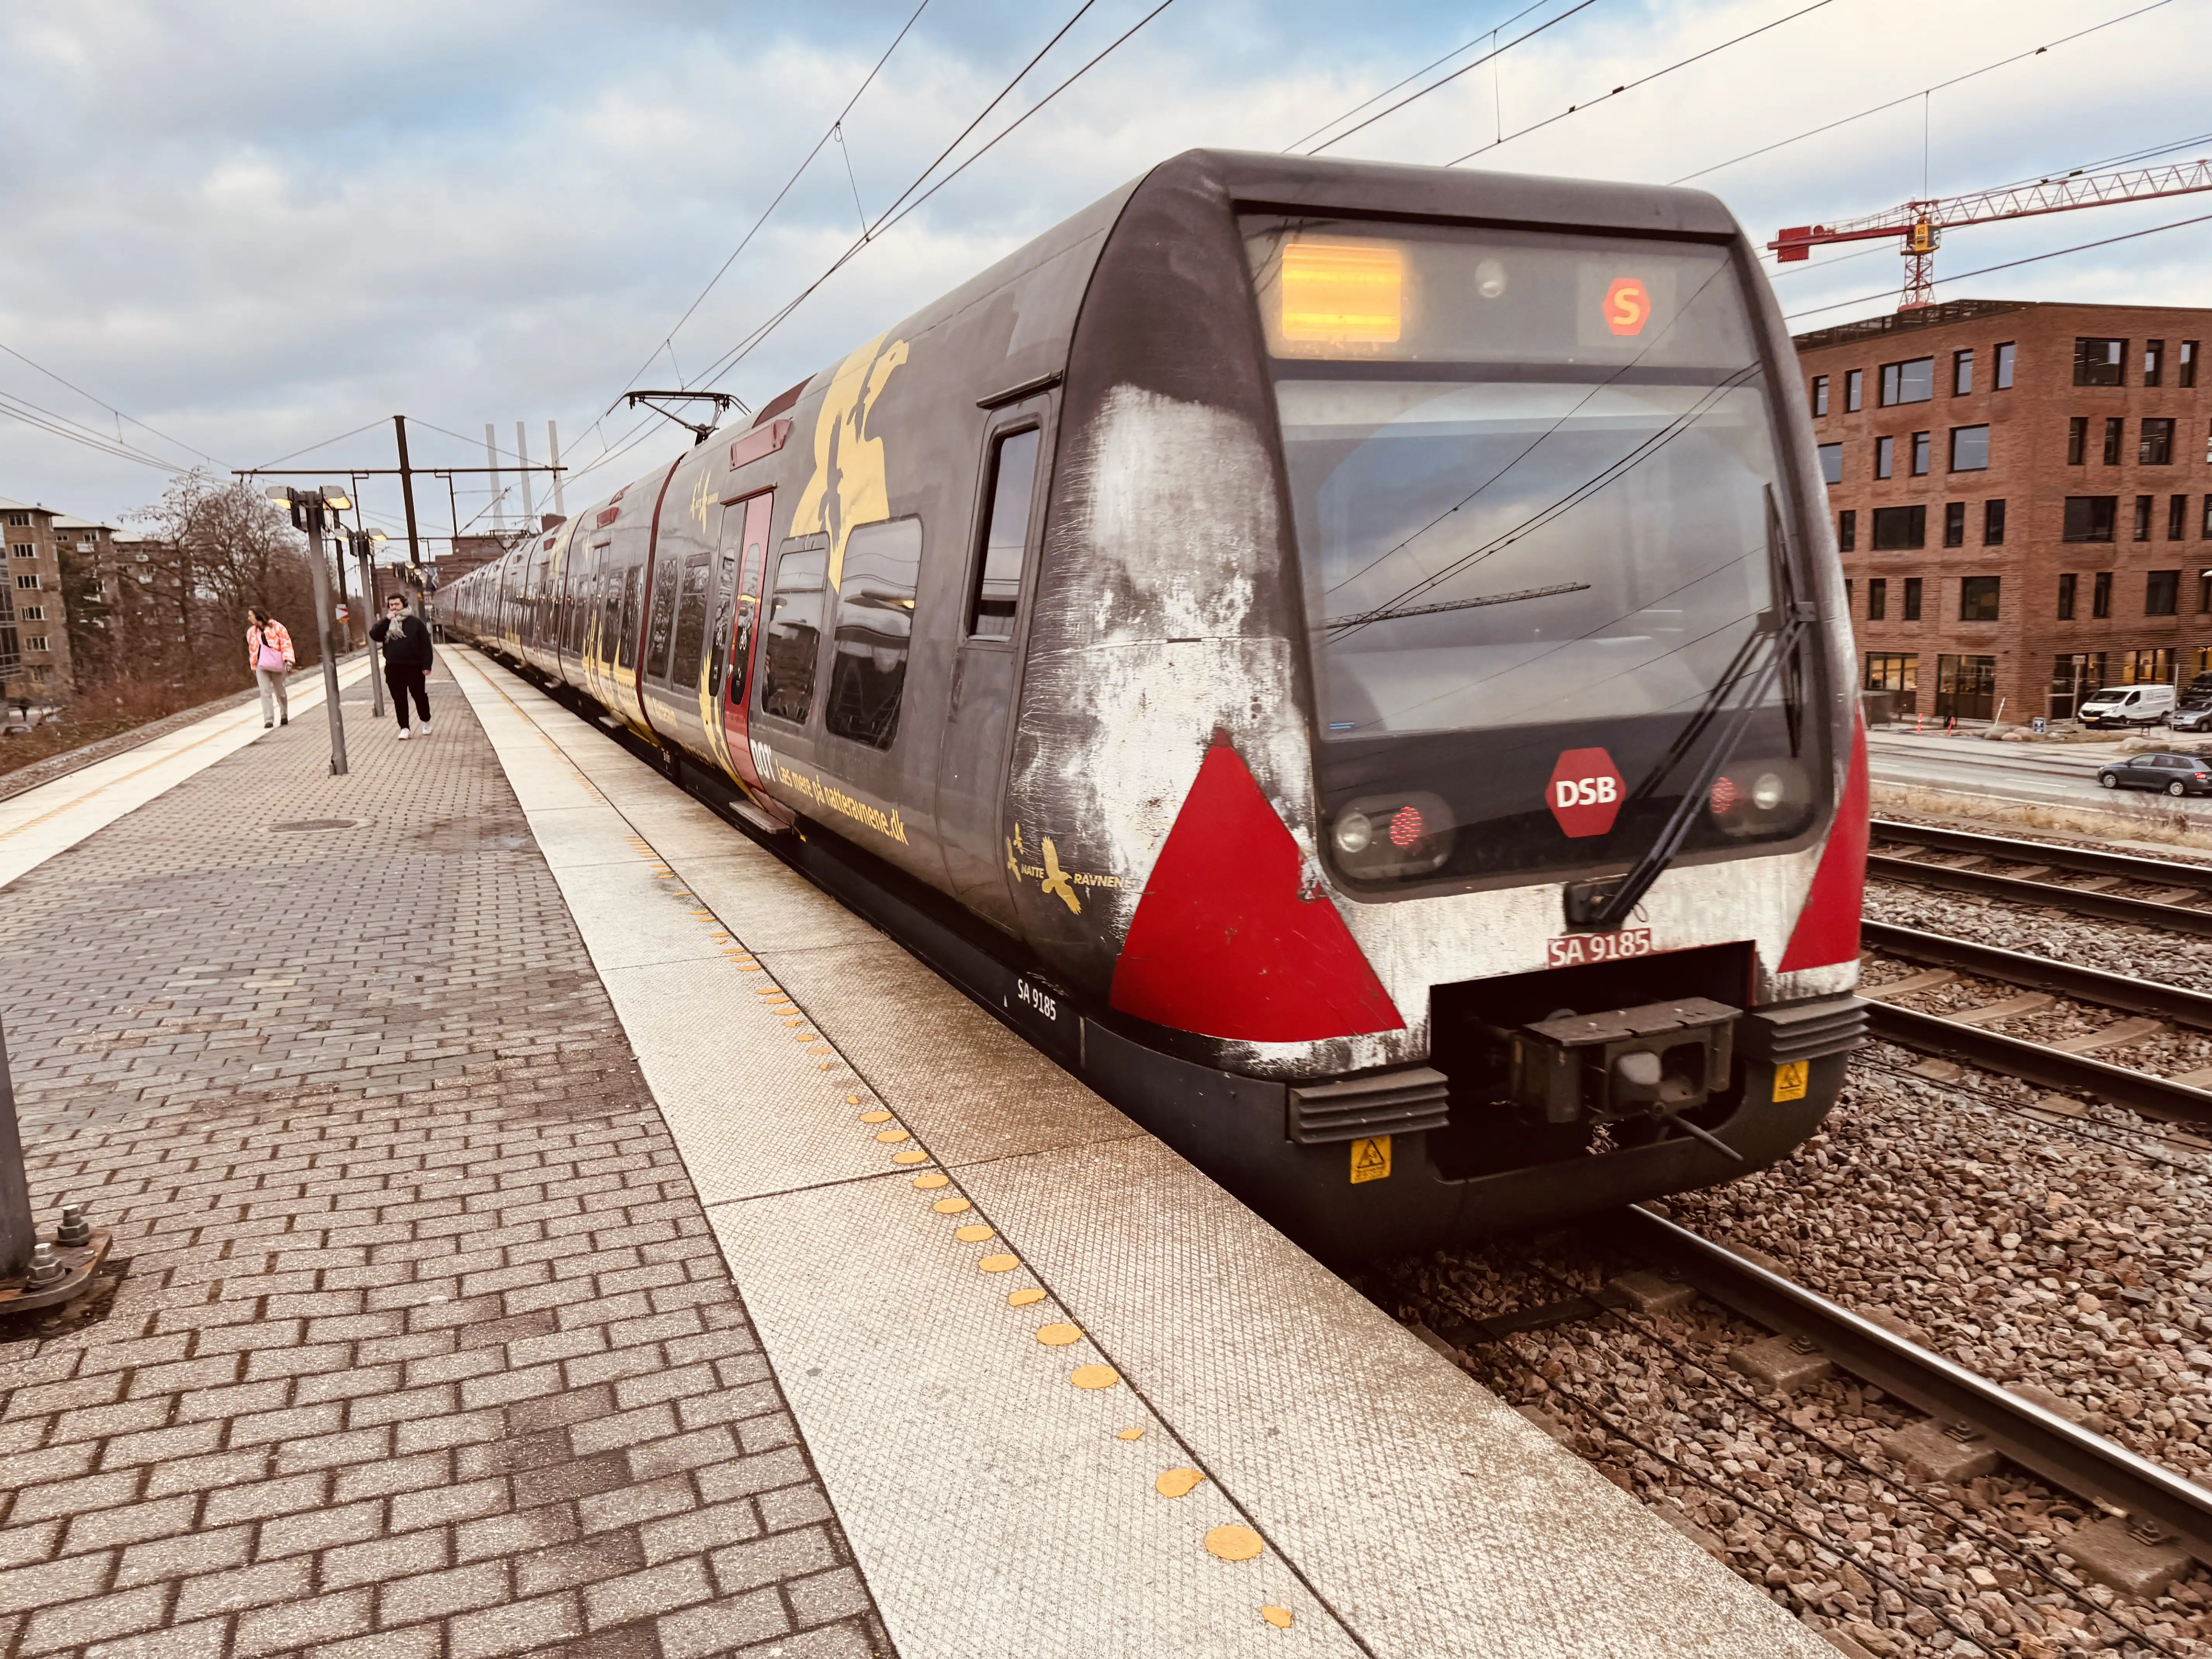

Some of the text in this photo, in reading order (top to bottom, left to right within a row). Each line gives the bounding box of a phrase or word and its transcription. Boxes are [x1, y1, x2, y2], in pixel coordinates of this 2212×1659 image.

[1613, 287, 1640, 325] S
[750, 738, 776, 782] DOT
[775, 758, 909, 846] Læs mere på natteravnene.dk
[1556, 776, 1617, 808] DSB
[1021, 863, 1131, 889] NATTE RAVNENE
[1550, 930, 1650, 967] SA 9185
[1018, 978, 1056, 1021] SA 9185
